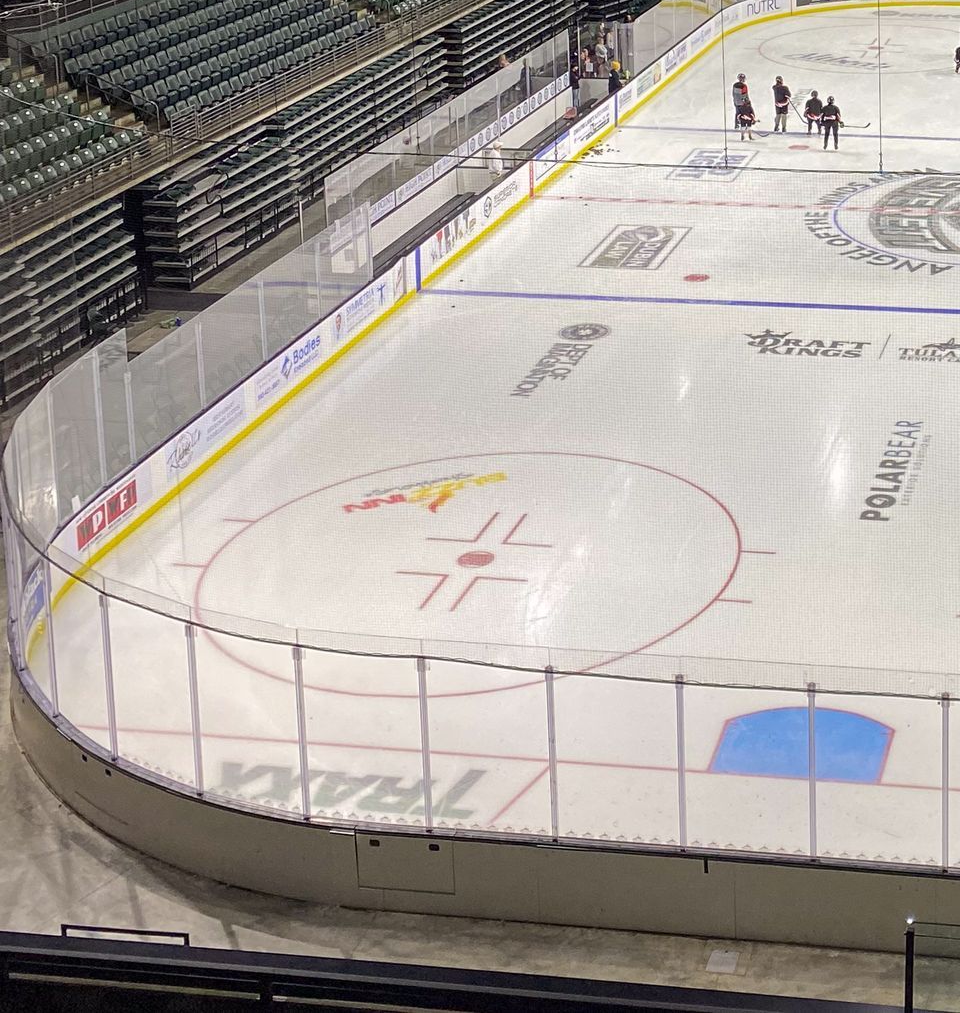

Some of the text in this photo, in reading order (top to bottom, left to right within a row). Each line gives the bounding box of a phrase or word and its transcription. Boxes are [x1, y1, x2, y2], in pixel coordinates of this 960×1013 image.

[804, 212, 831, 237] THE
[818, 229, 848, 247] OF
[838, 246, 953, 276] ANGEL
[293, 335, 321, 364] Bodies
[747, 336, 871, 350] DRAFT
[759, 346, 862, 359] KINGS
[859, 420, 924, 522] POLARBEAR
[220, 761, 487, 820] TRAXX
